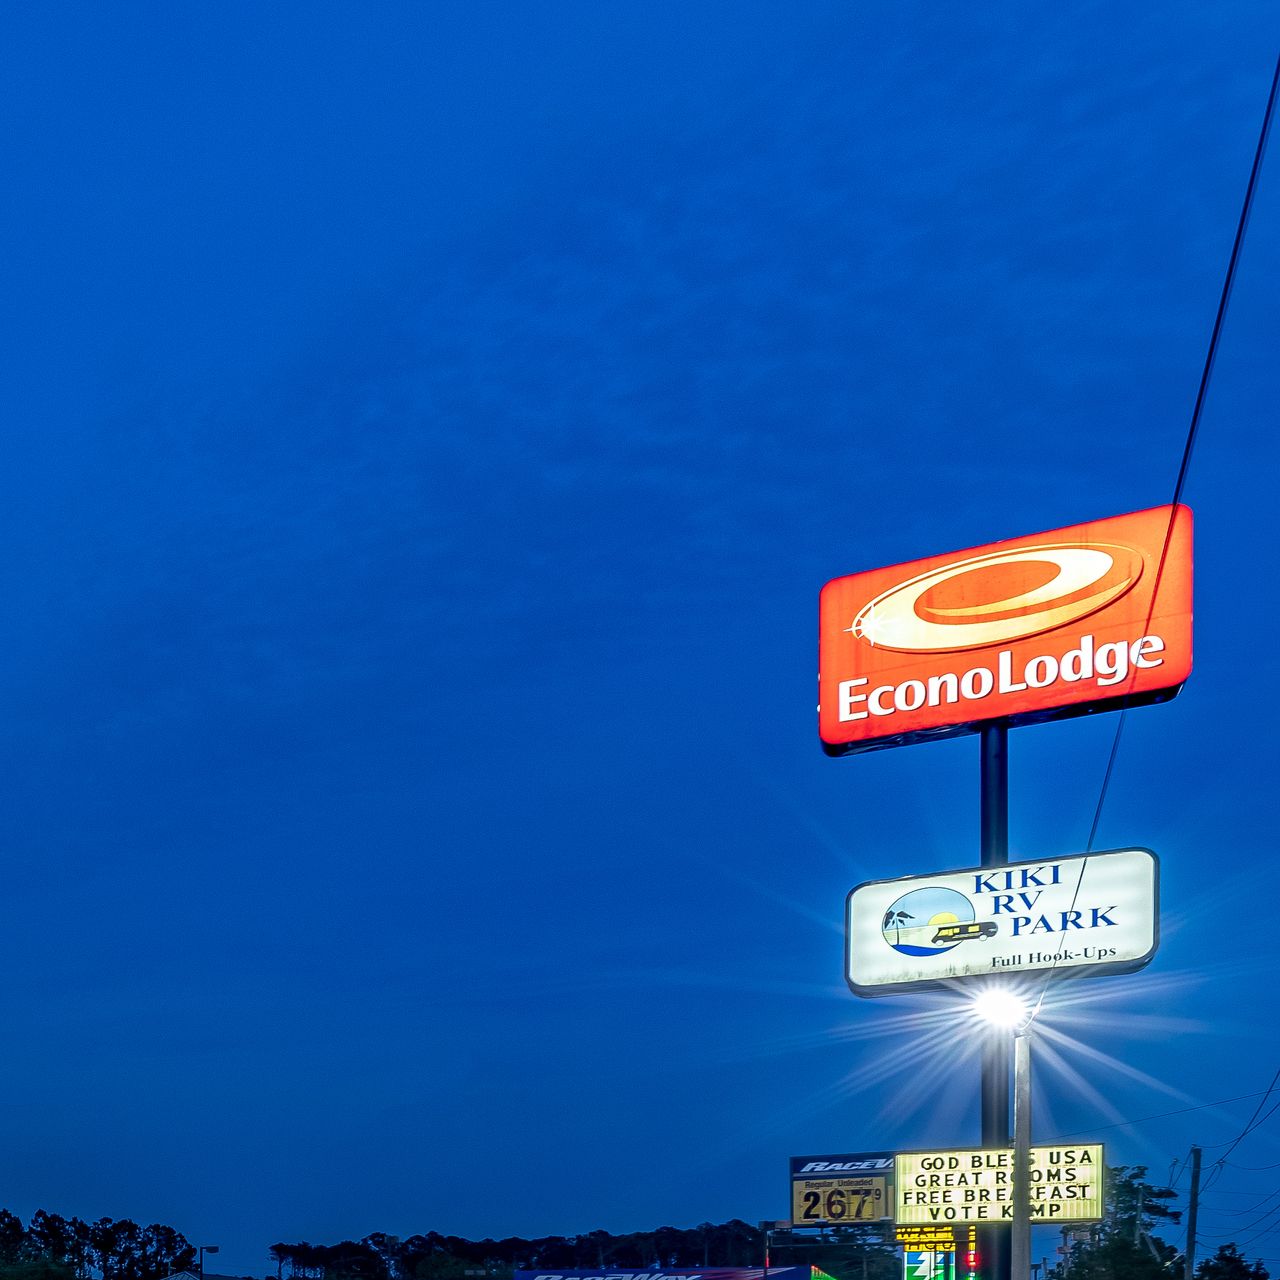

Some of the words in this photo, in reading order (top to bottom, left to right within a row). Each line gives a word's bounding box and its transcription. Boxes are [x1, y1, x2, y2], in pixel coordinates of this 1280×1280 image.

[838, 633, 1165, 723] EconoLodge
[972, 863, 1062, 895] KIKI
[991, 889, 1044, 916] RV
[1010, 905, 1119, 937] PARK
[991, 954, 1021, 968] Full
[1025, 946, 1117, 964] Hook-Ups
[921, 1157, 959, 1171] GOD
[971, 1152, 1036, 1169] BLES
[1049, 1150, 1092, 1165] USA
[805, 1181, 834, 1190] Regular
[837, 1178, 874, 1187] Unleaded
[915, 1172, 983, 1187] GREAT
[995, 1168, 1077, 1185] ROMS
[903, 1190, 952, 1204] FREE
[964, 1184, 1090, 1202] BREFAST
[929, 1205, 988, 1220] VOTE
[1002, 1203, 1061, 1218] KMP
